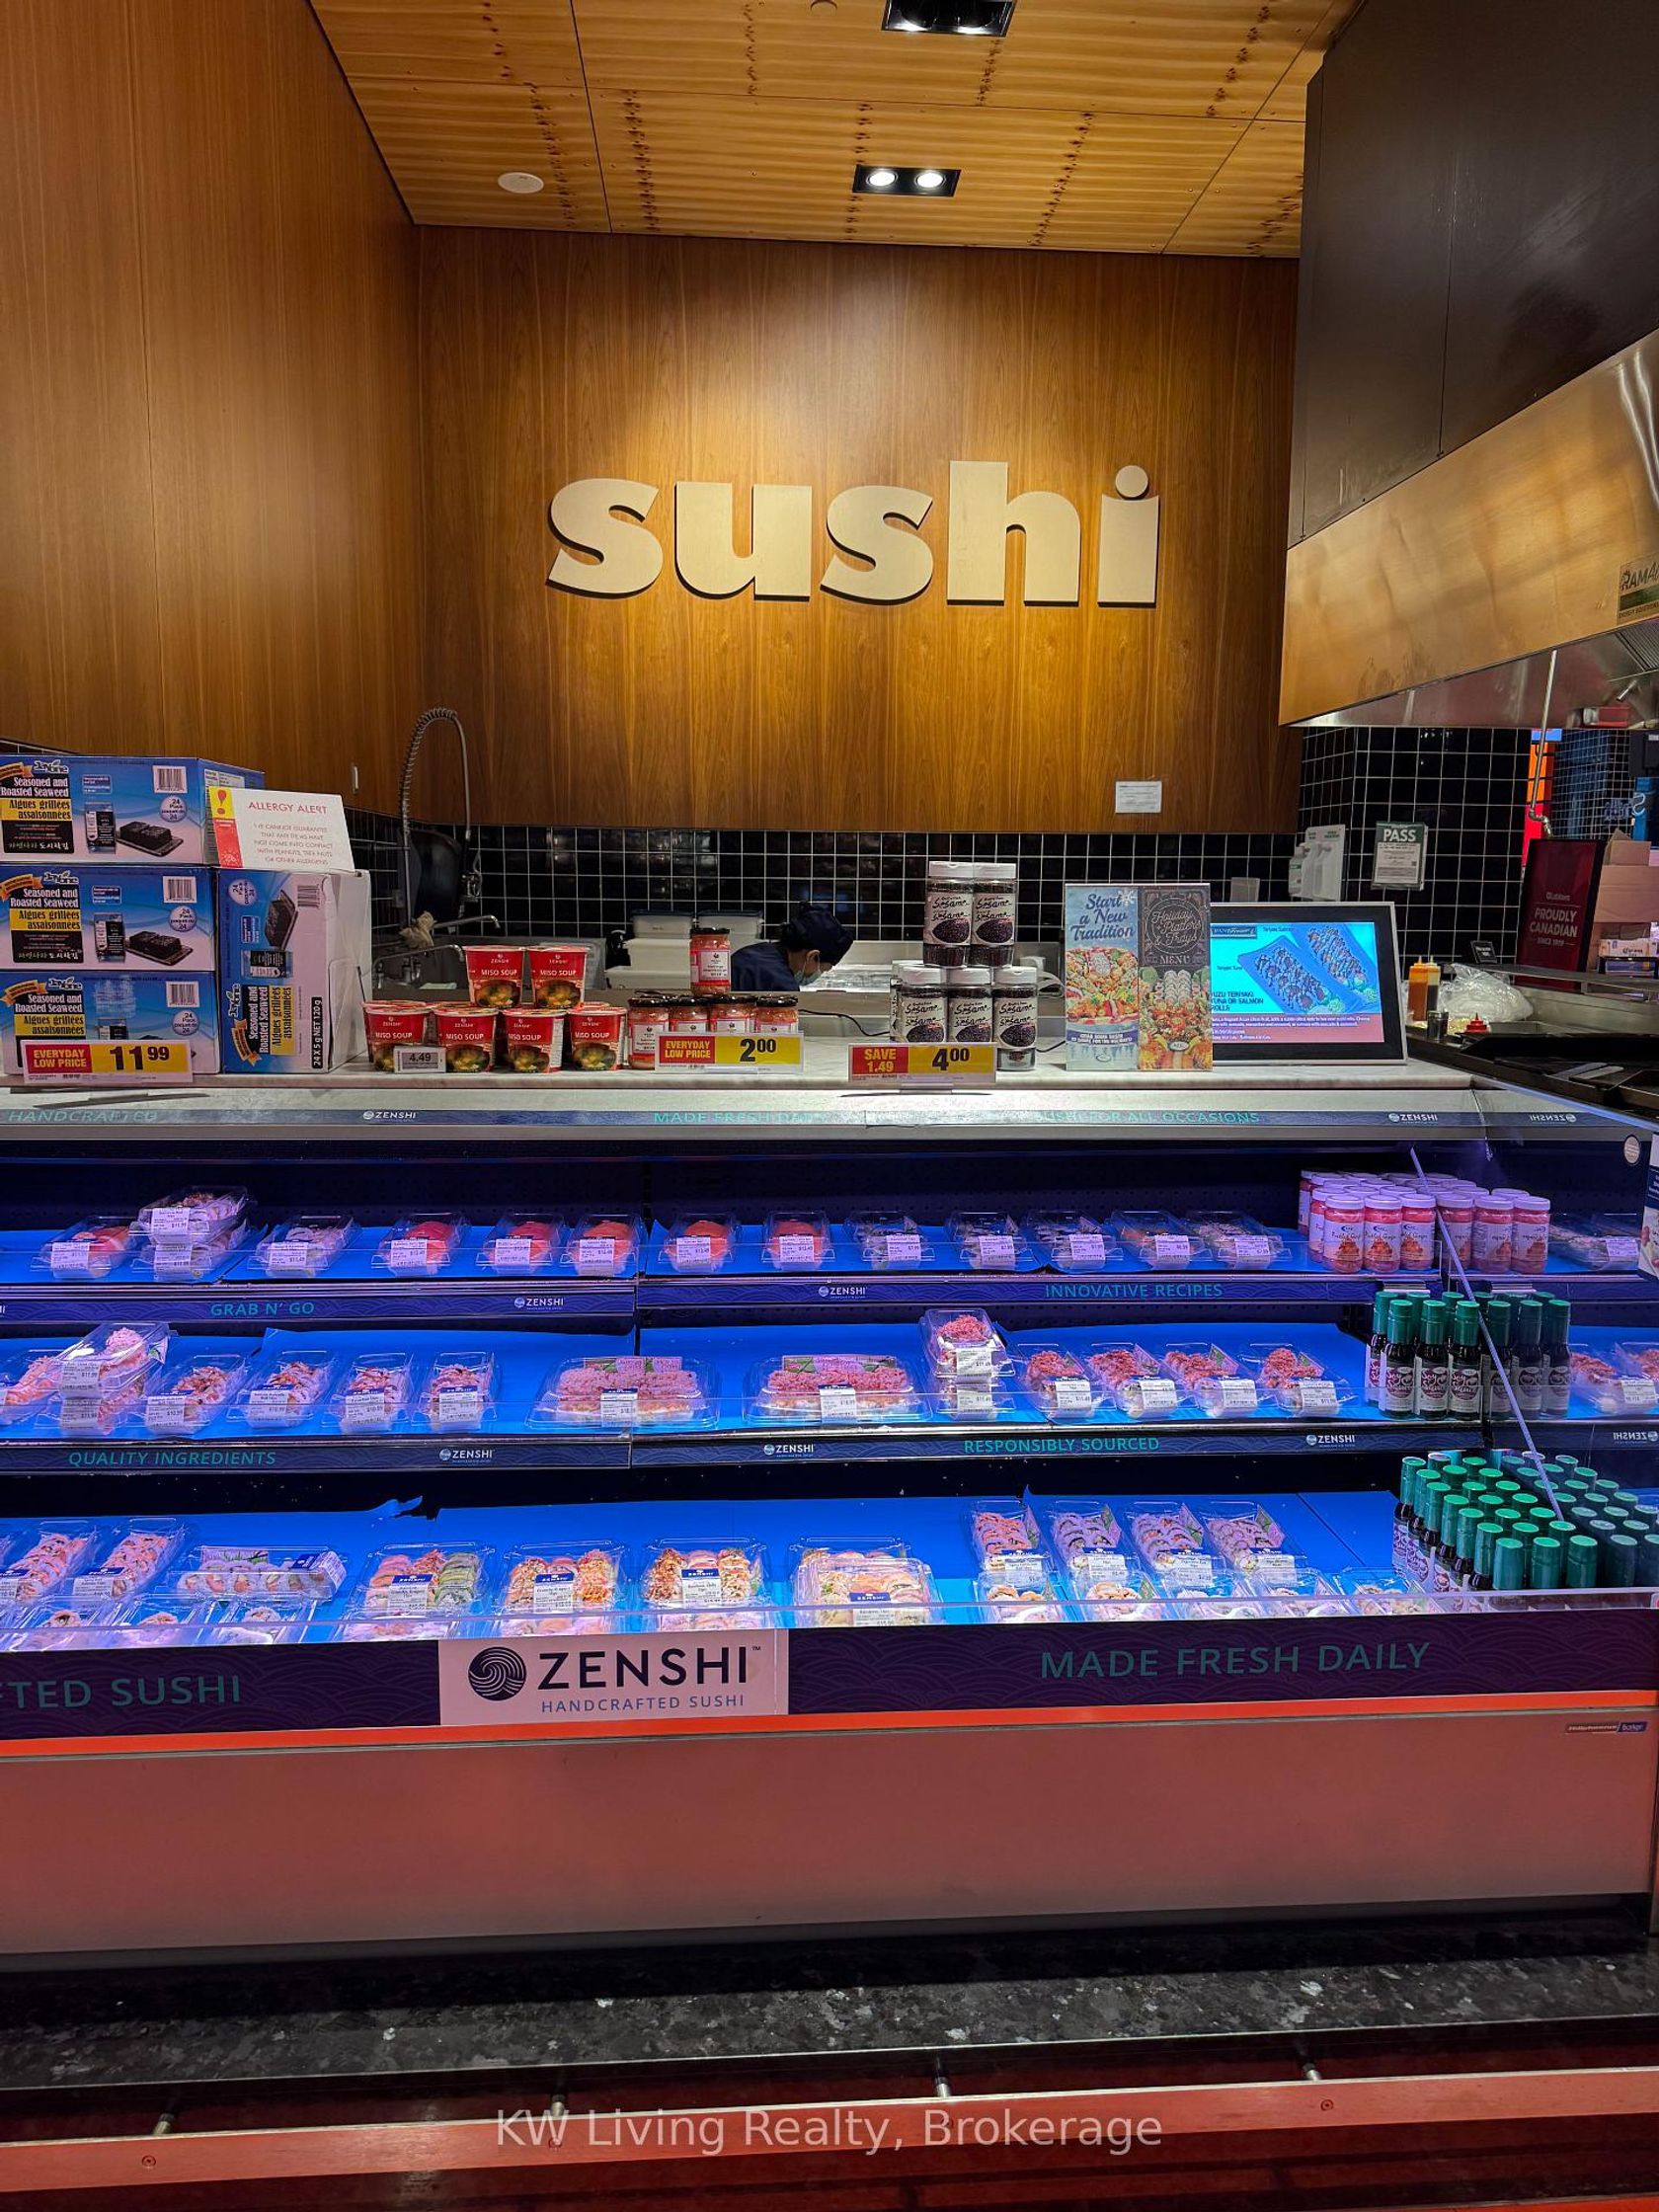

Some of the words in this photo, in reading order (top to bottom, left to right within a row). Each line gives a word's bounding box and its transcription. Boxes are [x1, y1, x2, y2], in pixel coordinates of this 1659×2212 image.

[547, 460, 1159, 606] sushi
[14, 777, 50, 787] Seasoned
[52, 777, 68, 787] and
[34, 787, 69, 797] Seaweed
[10, 799, 36, 810] Algues
[249, 802, 293, 812] ALLERGY
[297, 805, 327, 814] ALERT
[1383, 830, 1416, 842] PASS
[24, 889, 60, 898] Seasoned
[62, 889, 78, 898] and
[10, 898, 41, 908] Roasted
[43, 898, 79, 908] Seaweed
[1086, 894, 1122, 909] Start
[19, 909, 45, 920] Algues
[1079, 914, 1089, 924] a
[1094, 908, 1128, 923] New
[1535, 908, 1577, 921] PROUDLY
[1070, 924, 1134, 941] Tradition
[1531, 921, 1578, 937] CANADIAN
[1159, 955, 1190, 965] MENU
[28, 993, 65, 1003] Seasoned
[67, 993, 82, 1003] and
[248, 987, 258, 1001] and
[15, 1003, 46, 1013] Roasted
[48, 1003, 83, 1013] Seaweed
[259, 987, 269, 1021] Seaweed
[24, 1015, 49, 1025] Algues
[248, 1003, 258, 1040] Seasoned
[272, 1019, 281, 1046] Algues
[666, 1040, 710, 1050] EVERYDAY
[33, 1049, 85, 1059] EVERYDAY
[409, 1053, 432, 1063] 4.49
[665, 1050, 684, 1059] LOW
[685, 1049, 711, 1059] PRICE
[863, 1049, 897, 1061] SAVE
[34, 1059, 56, 1068] LOW
[57, 1058, 87, 1067] PRICE
[313, 1055, 321, 1066] 24
[867, 1061, 894, 1072] 1.49
[8, 1111, 158, 1123] HANDCRAFTED
[375, 1111, 417, 1120] ZENSHI
[654, 1113, 706, 1123] MADE
[715, 1113, 770, 1123] FRESH
[1162, 1112, 1259, 1123] OCCASIONS
[830, 1287, 866, 1296] ZENSHI
[1046, 1284, 1148, 1298] INNOVATIVE
[1155, 1284, 1223, 1297] RECIPES
[526, 1298, 564, 1306] ZENSHI
[210, 1304, 258, 1315] GRAB
[289, 1303, 314, 1314] GO
[1317, 1434, 1356, 1444] ZENSHI
[775, 1444, 814, 1454] ZENSHI
[964, 1439, 1075, 1454] RESPONSIBLY
[1081, 1438, 1159, 1452] SOURCED
[69, 1452, 149, 1467] QUALITY
[154, 1451, 276, 1465] INGREDIENTS
[452, 1450, 493, 1459] ZENSHI
[1041, 1649, 1158, 1679] MADE
[1177, 1646, 1299, 1676] FRESH
[1318, 1642, 1430, 1672] DAILY
[537, 1646, 747, 1691] ZENSHI
[111, 1675, 240, 1706] SUSHI
[542, 1697, 679, 1713] HANDCRAFTED
[689, 1695, 744, 1708] SUSHI
